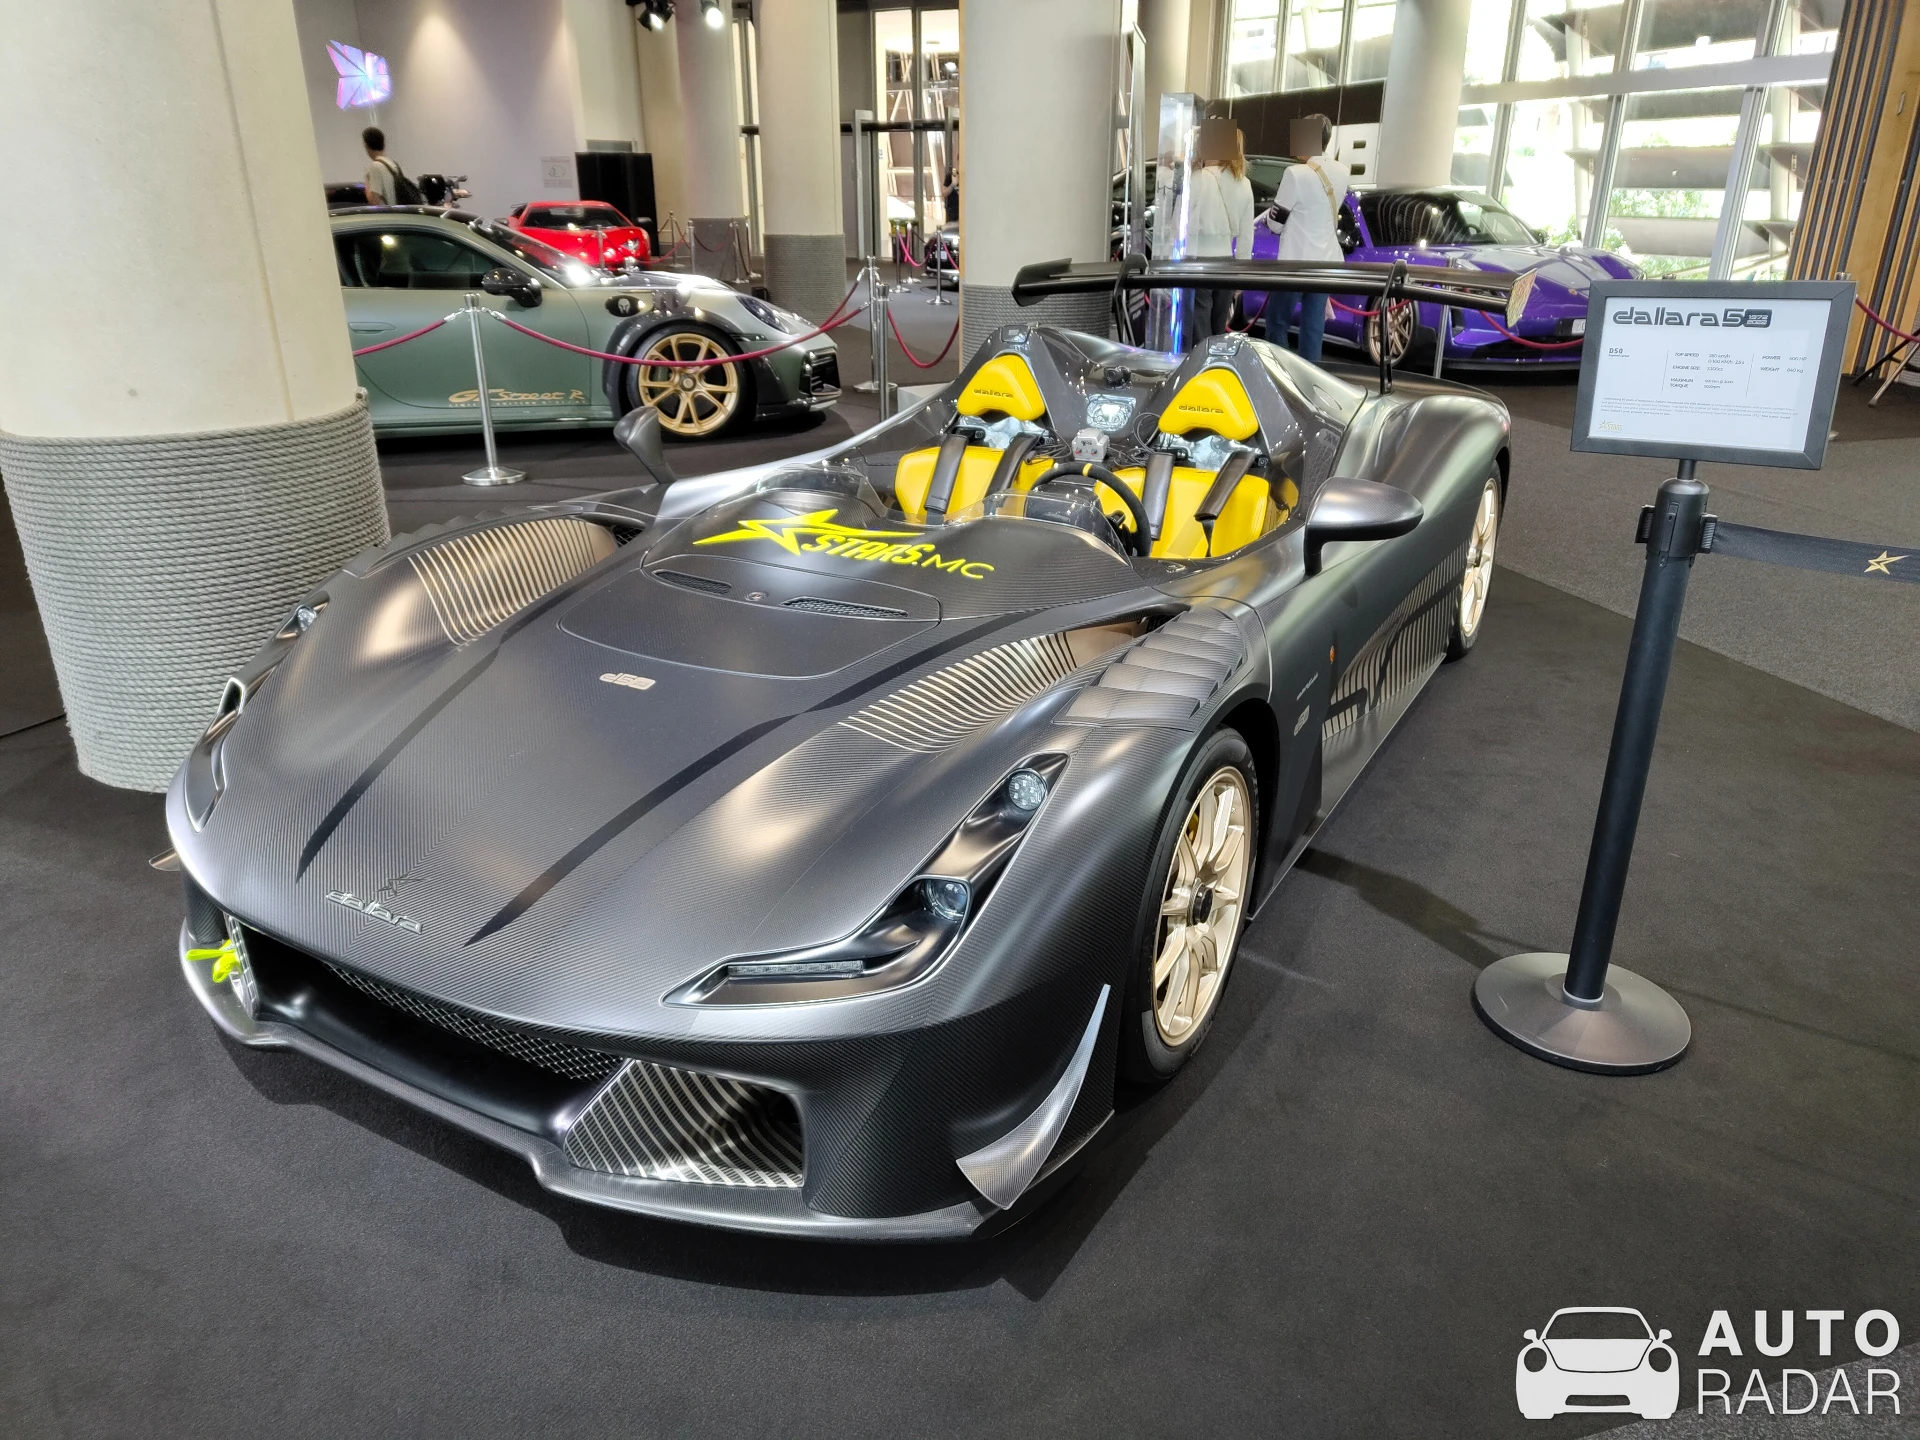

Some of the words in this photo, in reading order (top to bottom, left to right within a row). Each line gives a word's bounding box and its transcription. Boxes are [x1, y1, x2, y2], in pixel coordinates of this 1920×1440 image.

[569, 389, 585, 400] R
[973, 387, 1014, 399] dallara
[1178, 403, 1224, 414] dallara
